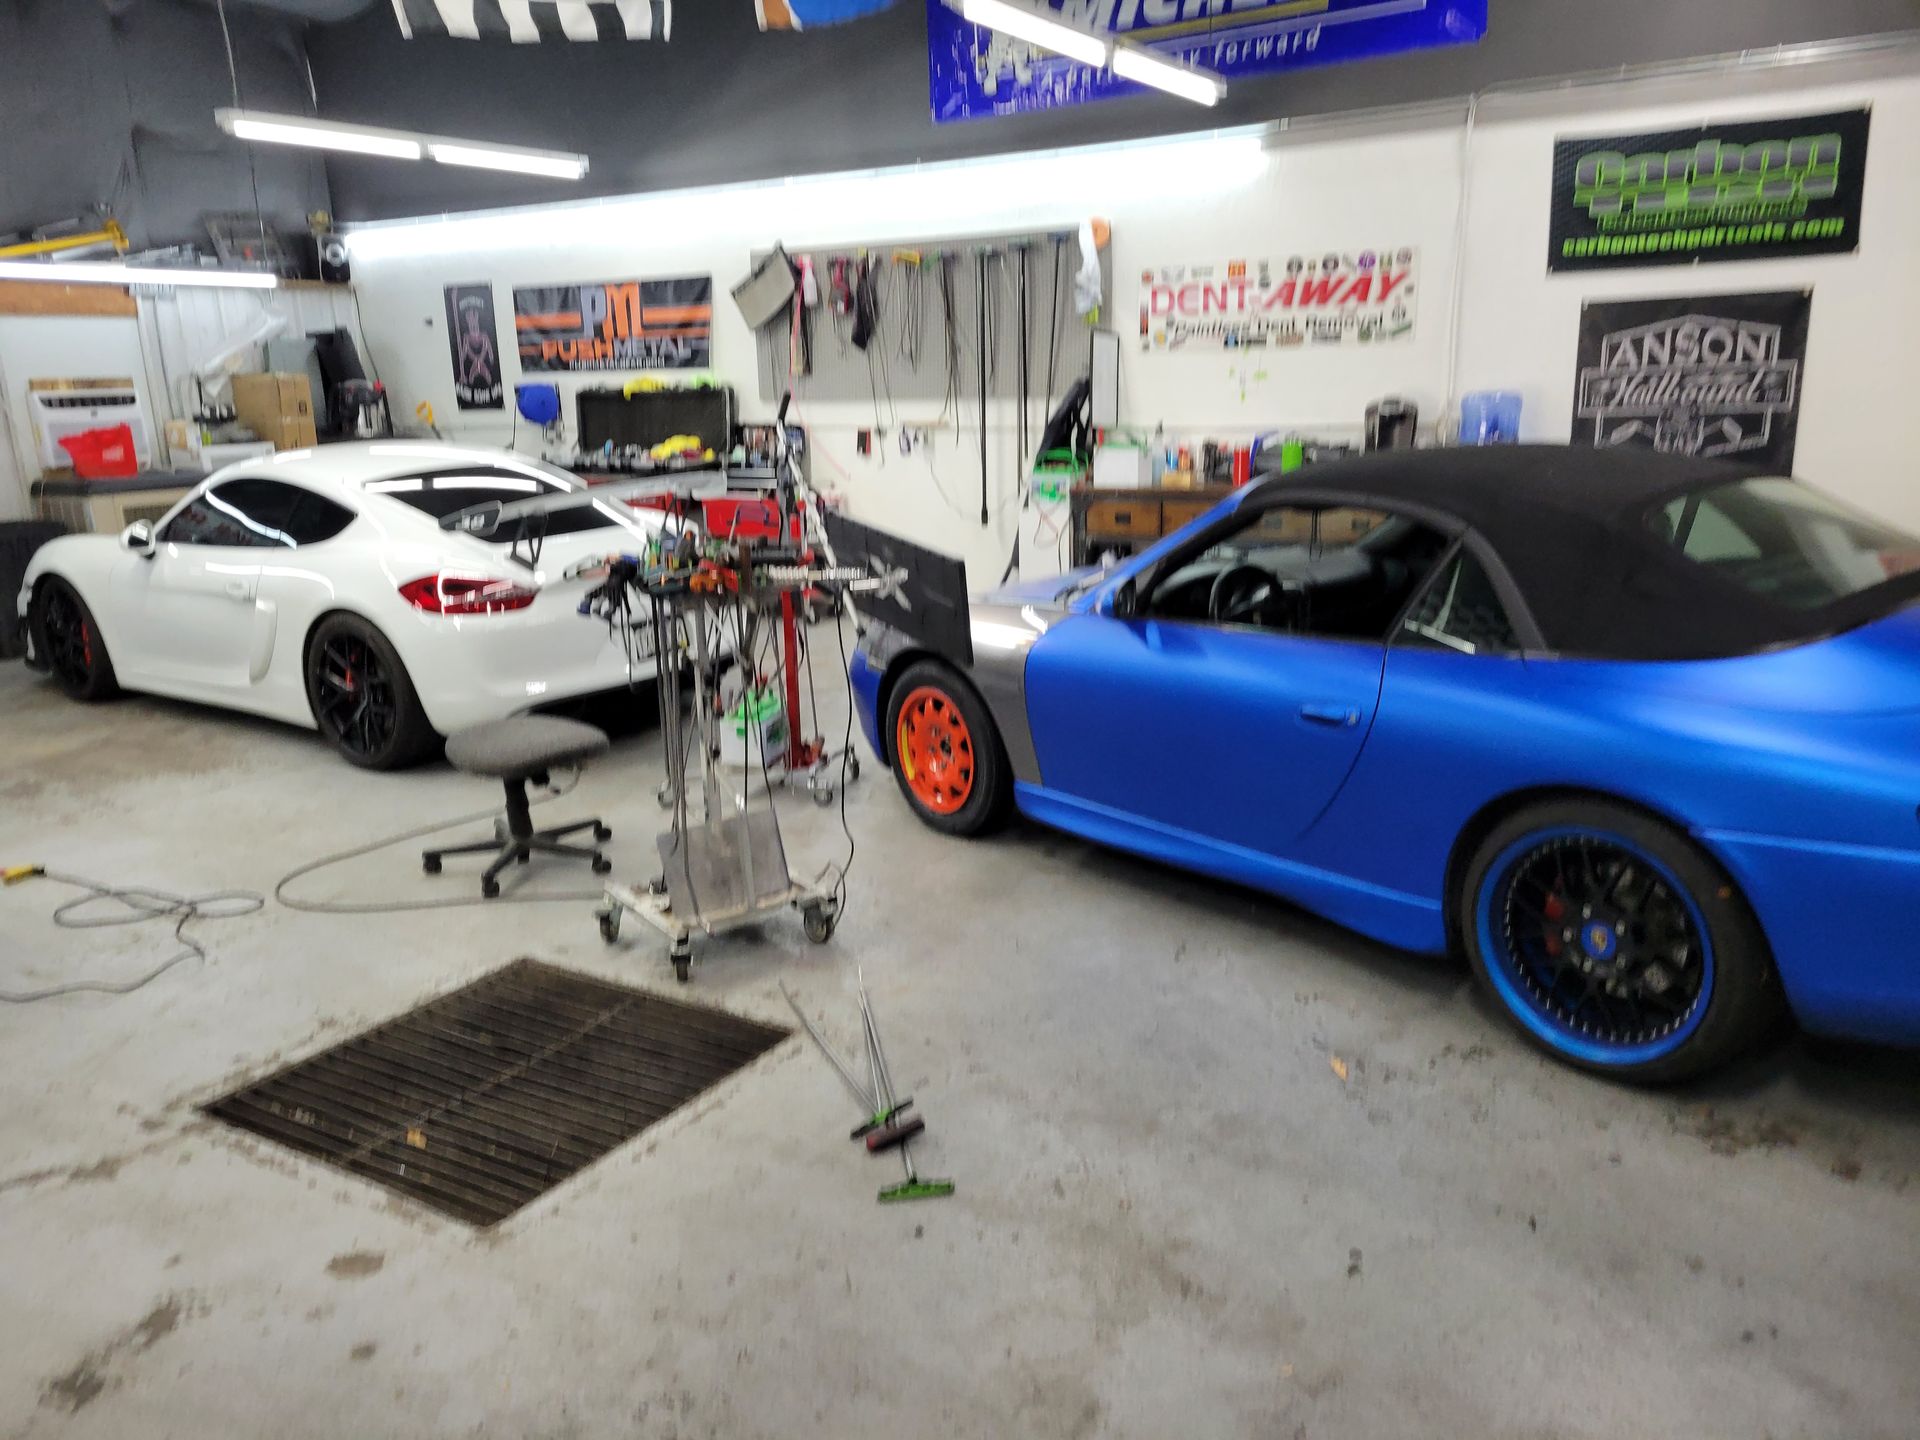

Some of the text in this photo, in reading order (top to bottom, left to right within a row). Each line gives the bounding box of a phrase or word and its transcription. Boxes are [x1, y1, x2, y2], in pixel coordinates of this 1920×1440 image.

[1214, 24, 1321, 67] forward
[580, 282, 642, 338] PM
[1608, 325, 1767, 372] ANSON
